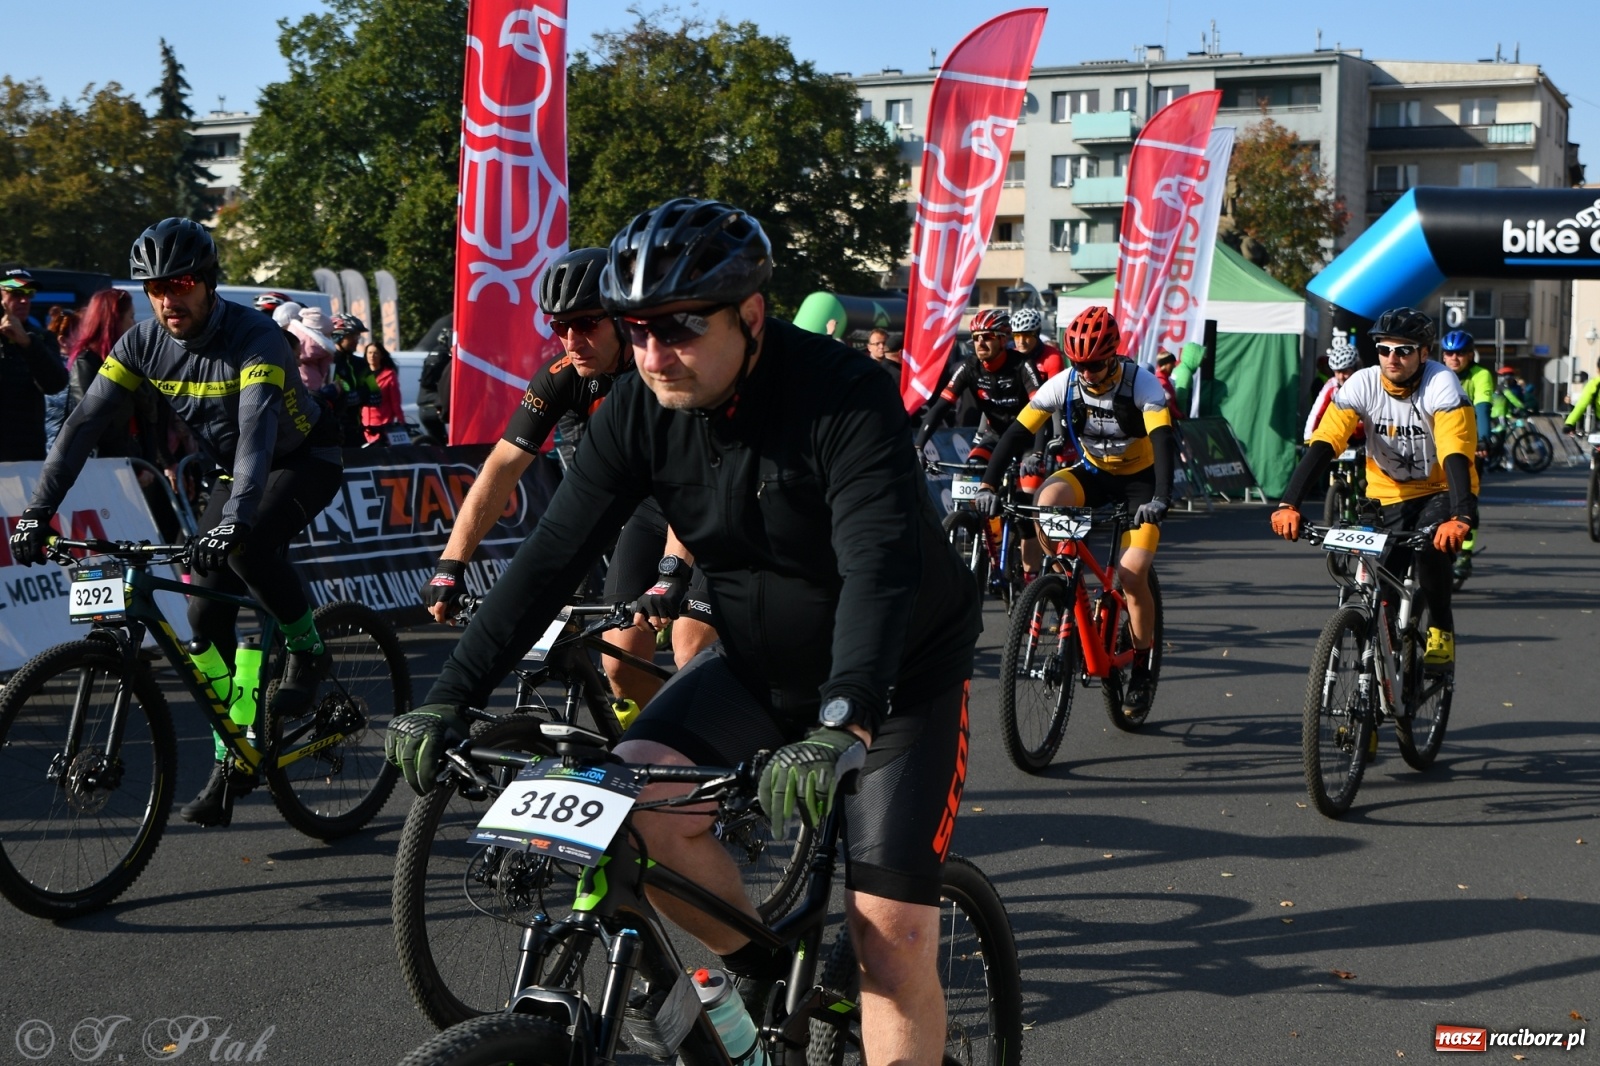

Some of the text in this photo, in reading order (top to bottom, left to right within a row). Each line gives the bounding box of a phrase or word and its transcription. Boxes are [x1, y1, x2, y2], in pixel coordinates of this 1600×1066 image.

[1502, 218, 1581, 254] bike
[959, 485, 979, 495] 309
[9, 531, 30, 545] FOX
[198, 536, 229, 550] FOX
[1334, 532, 1375, 546] 2696
[5, 571, 70, 607] MORE
[75, 586, 113, 607] 3292
[297, 733, 341, 757] SCOTT
[510, 790, 605, 828] 3189
